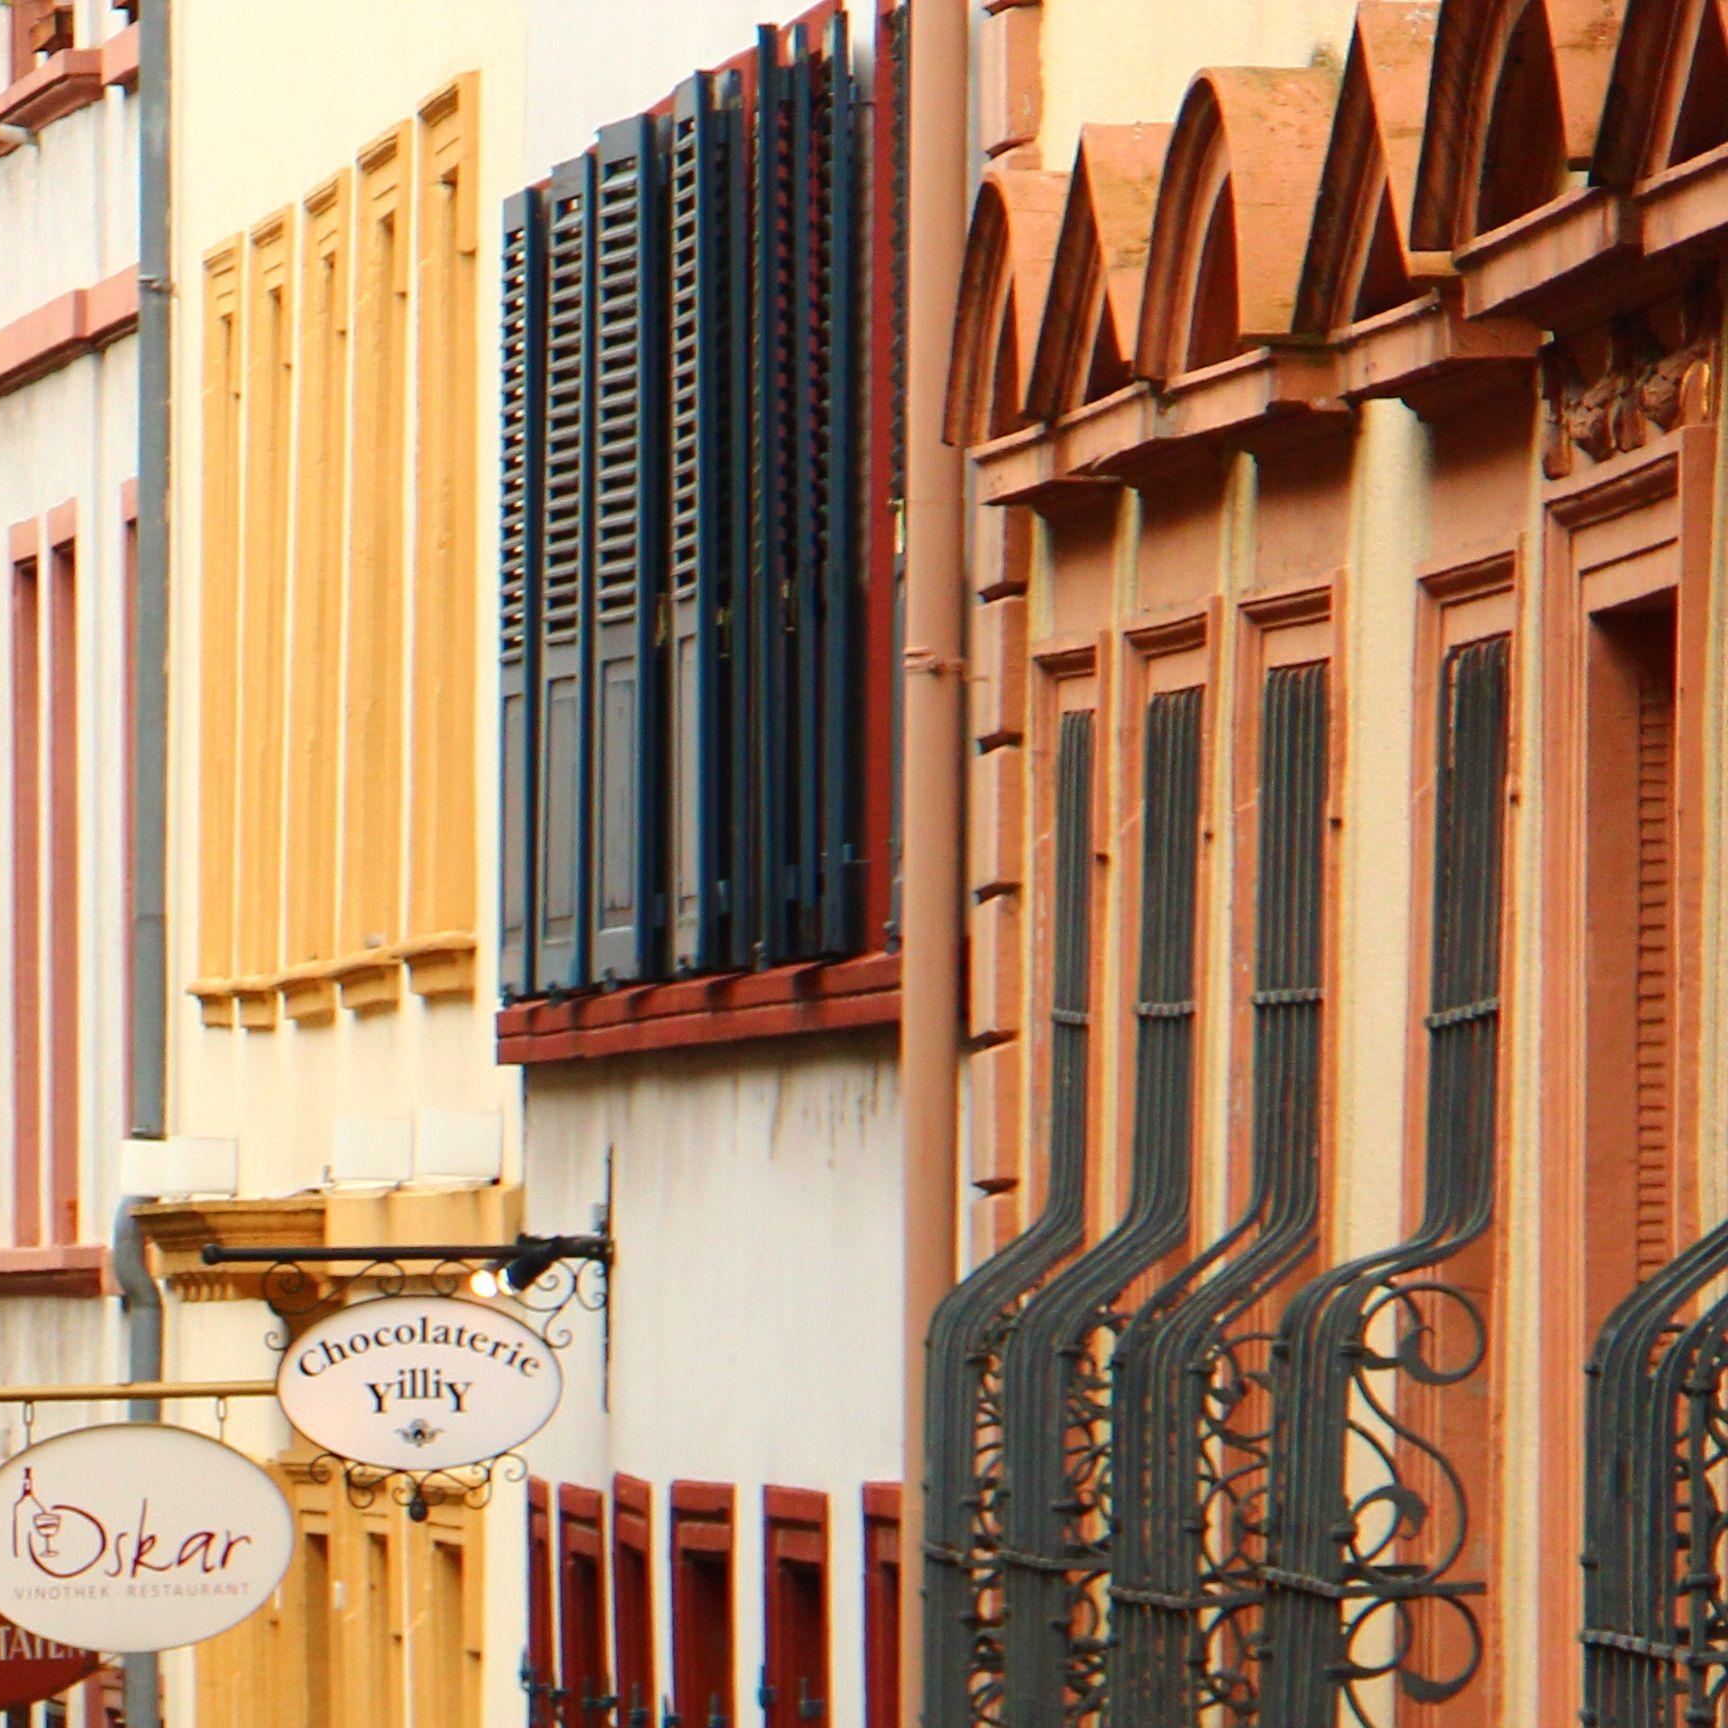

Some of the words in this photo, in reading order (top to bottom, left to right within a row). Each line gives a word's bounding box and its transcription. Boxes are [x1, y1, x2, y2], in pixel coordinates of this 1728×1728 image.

[297, 1315, 541, 1378] Chocolaterie
[28, 1497, 252, 1579] Oskar
[14, 1586, 113, 1601] VINOTHEK
[126, 1582, 250, 1599] RESTAURANT
